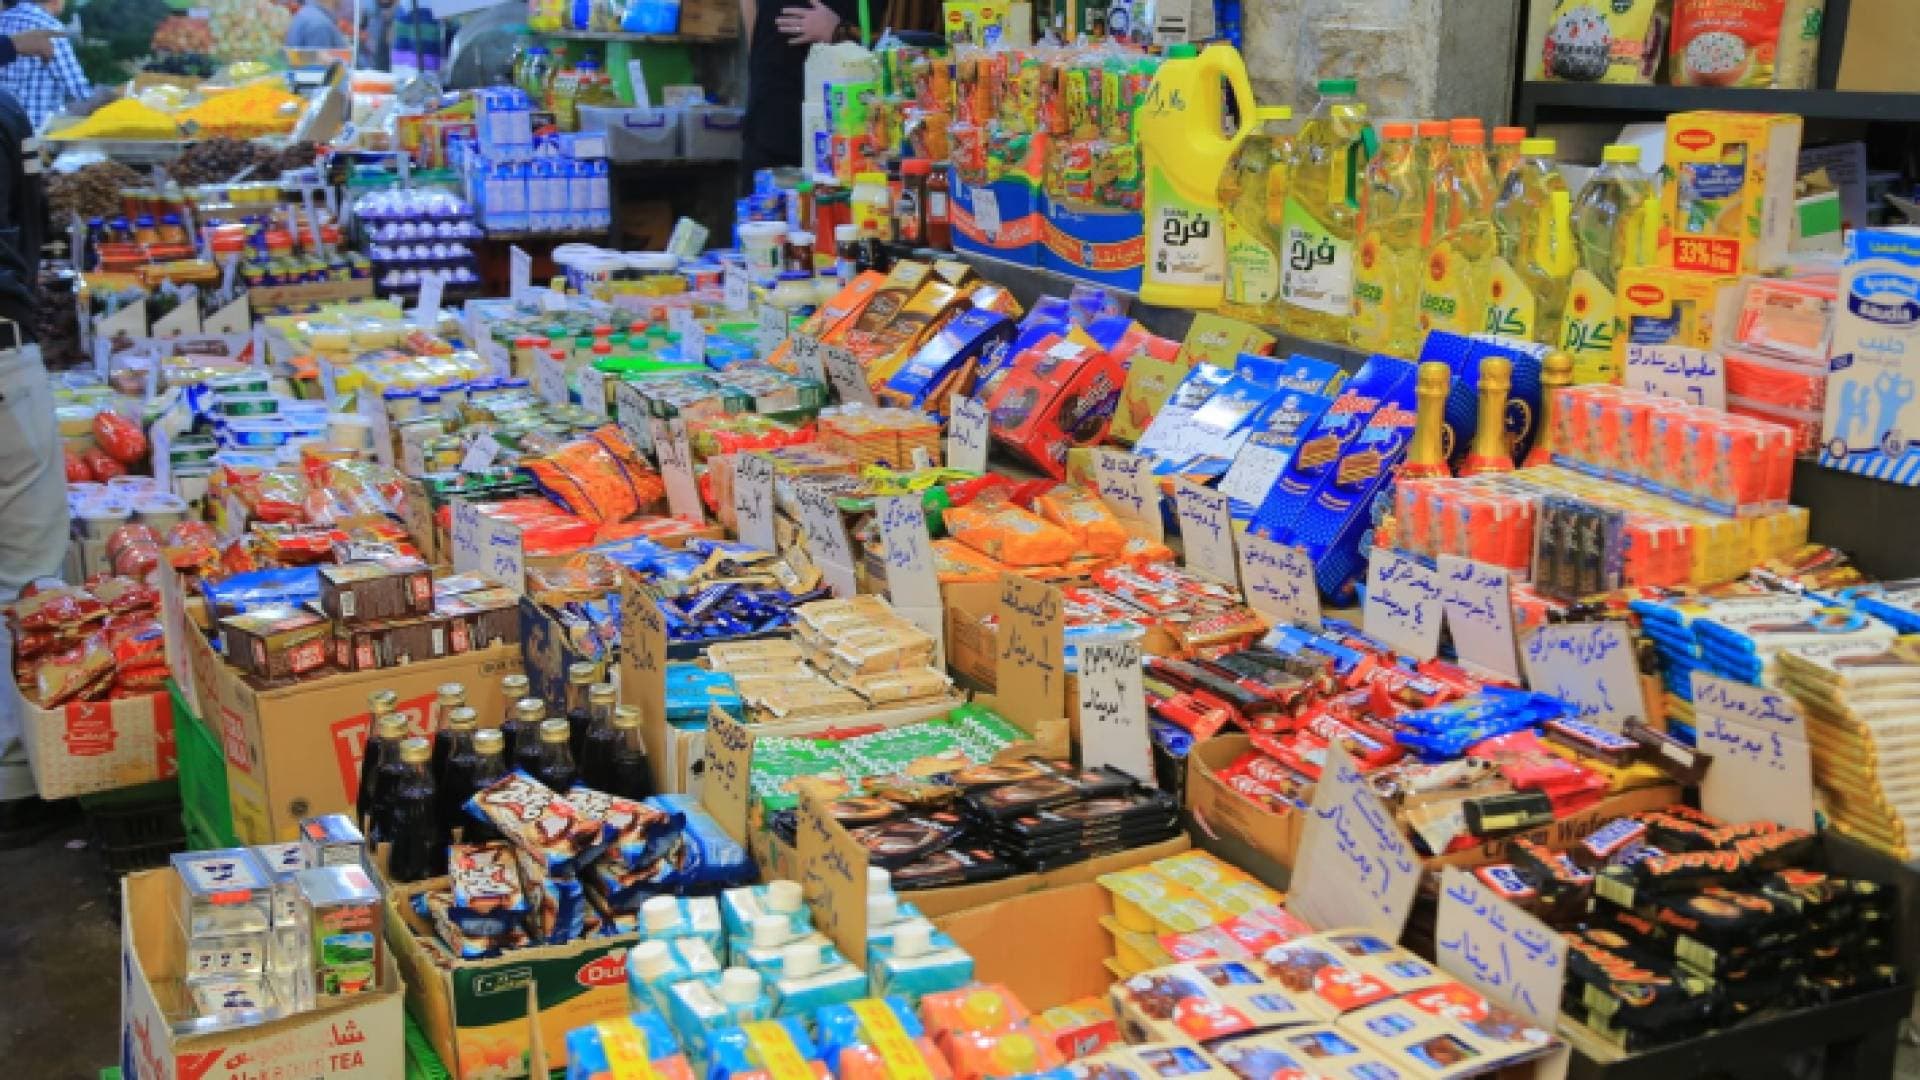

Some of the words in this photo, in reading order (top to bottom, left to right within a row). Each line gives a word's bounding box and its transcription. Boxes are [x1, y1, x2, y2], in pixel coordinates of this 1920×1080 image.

[1163, 213, 1210, 247] فرح
[1290, 239, 1336, 271] فرح
[328, 1050, 365, 1072] TEA
